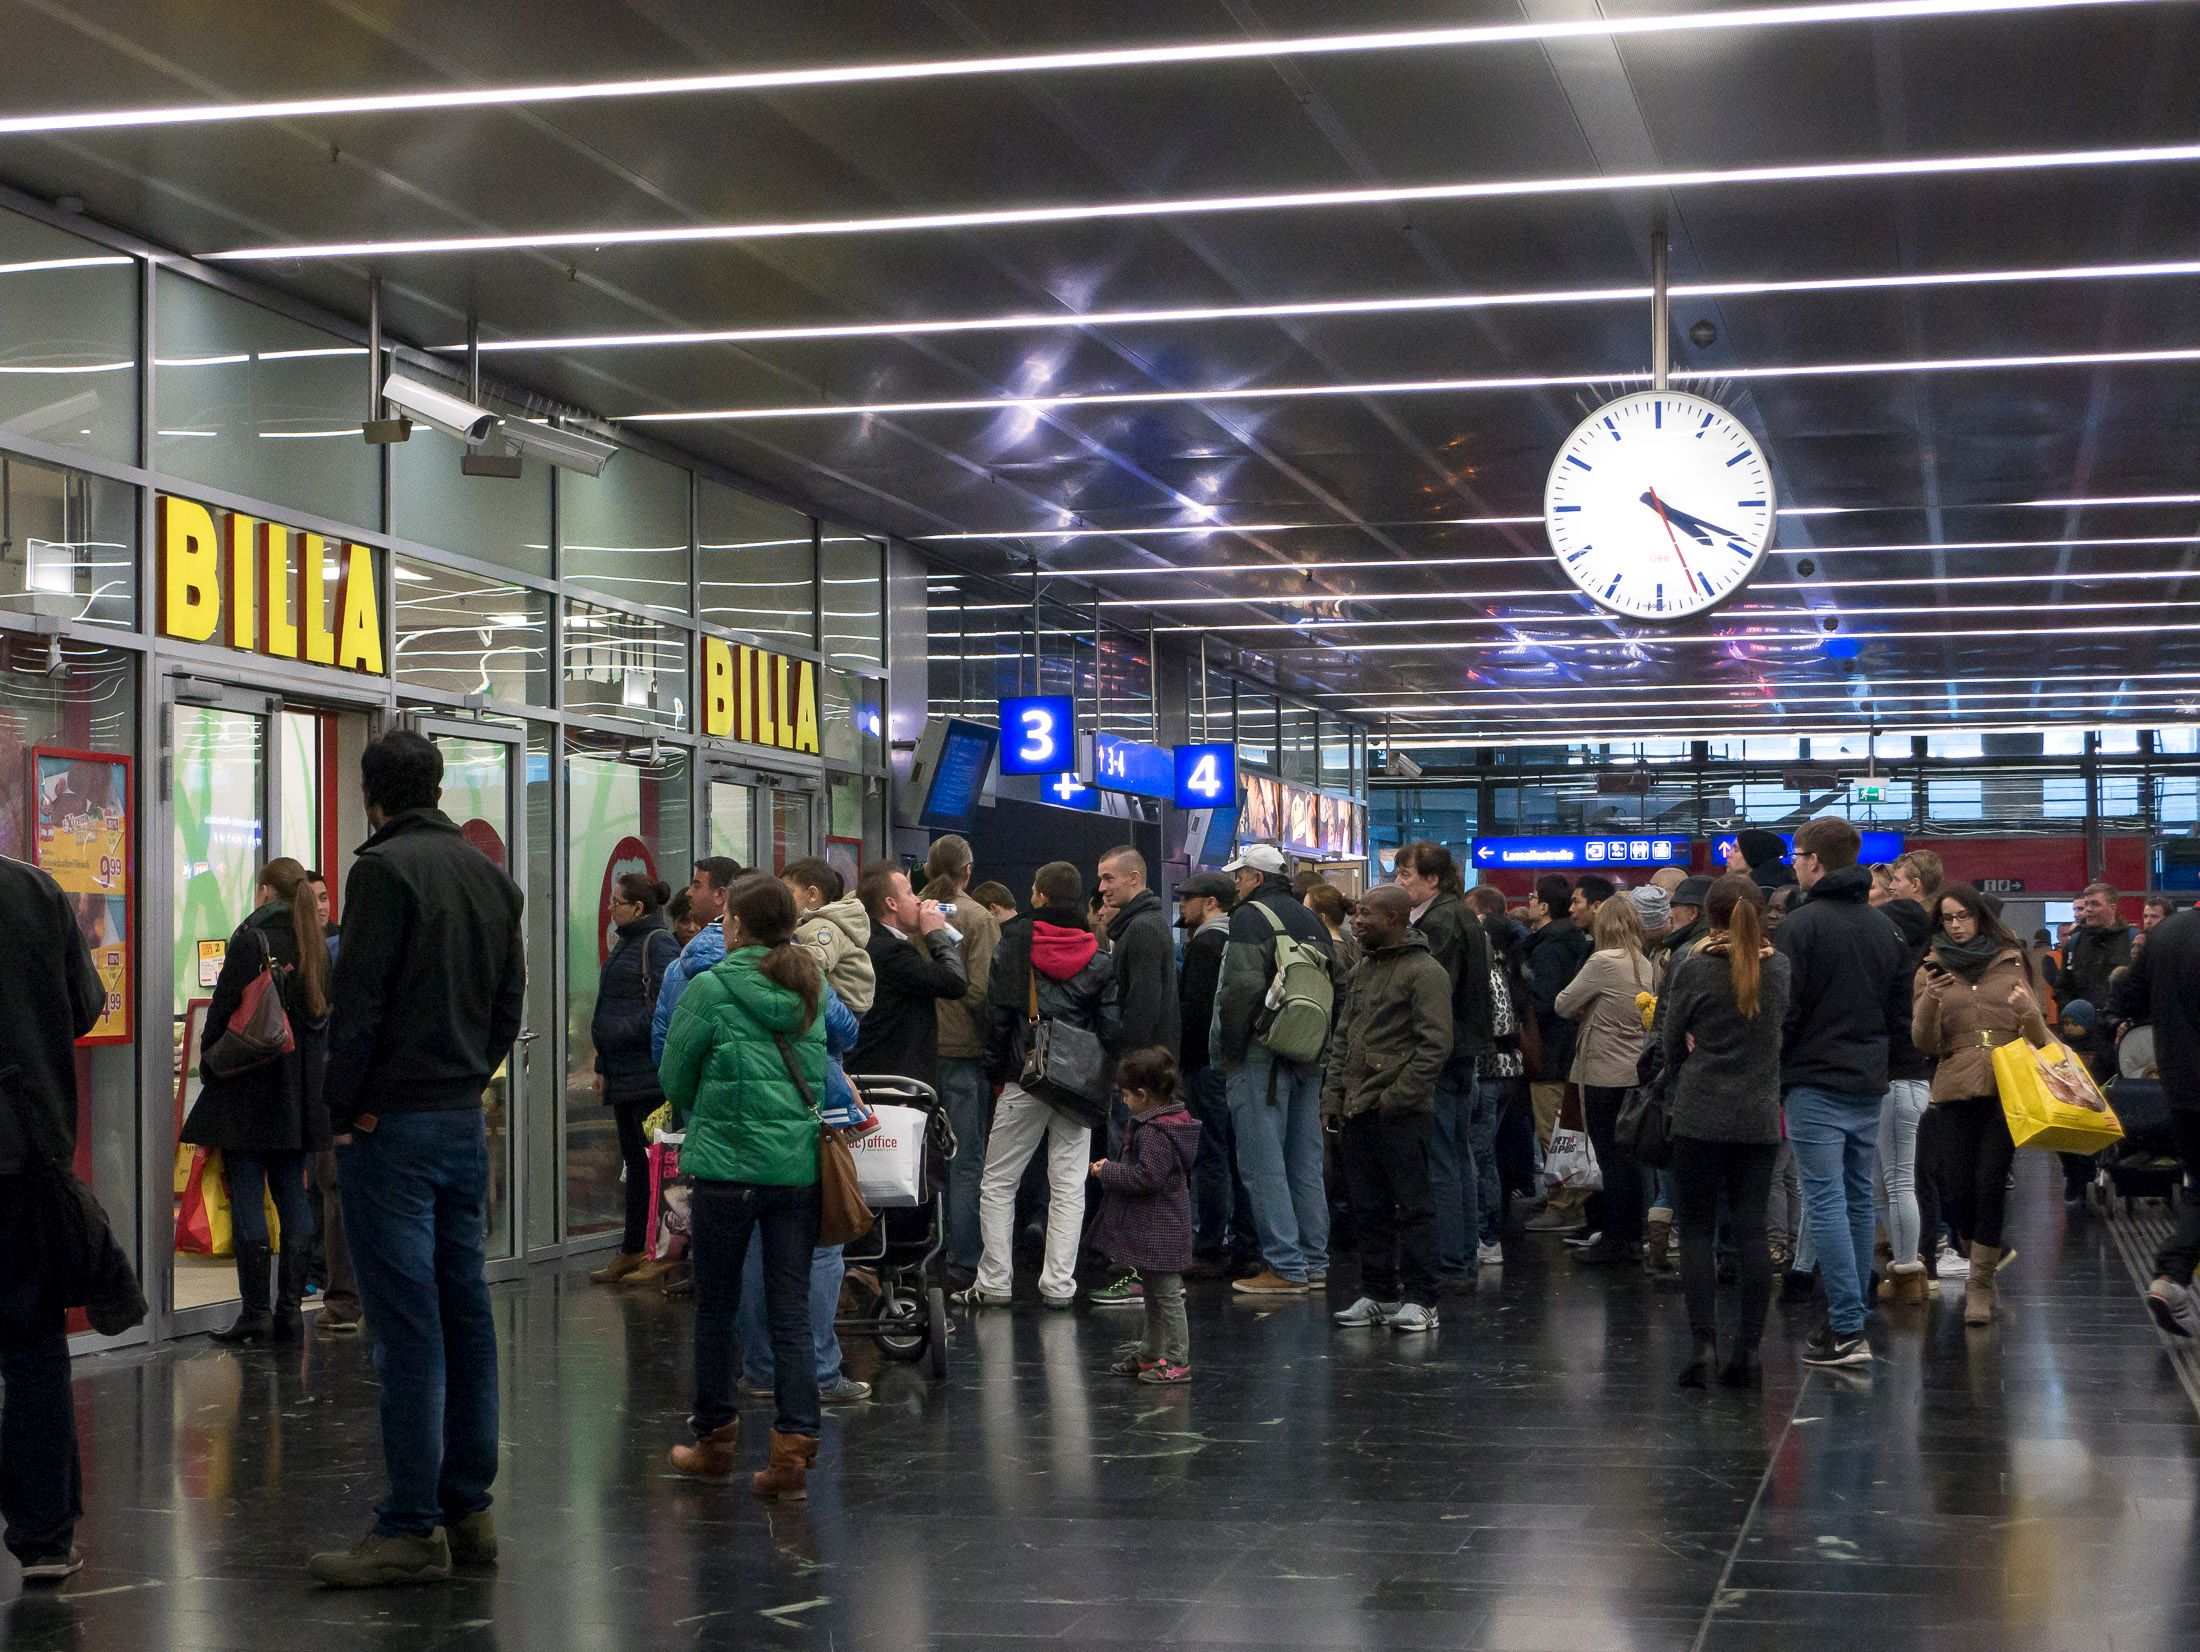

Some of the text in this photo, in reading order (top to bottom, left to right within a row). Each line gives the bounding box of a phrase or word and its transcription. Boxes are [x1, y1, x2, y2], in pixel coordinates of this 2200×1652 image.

[157, 495, 384, 675] BILLA
[701, 636, 821, 753] BILLA
[1020, 709, 1054, 761] 3
[1187, 755, 1221, 797] 4
[867, 1135, 897, 1149] office
